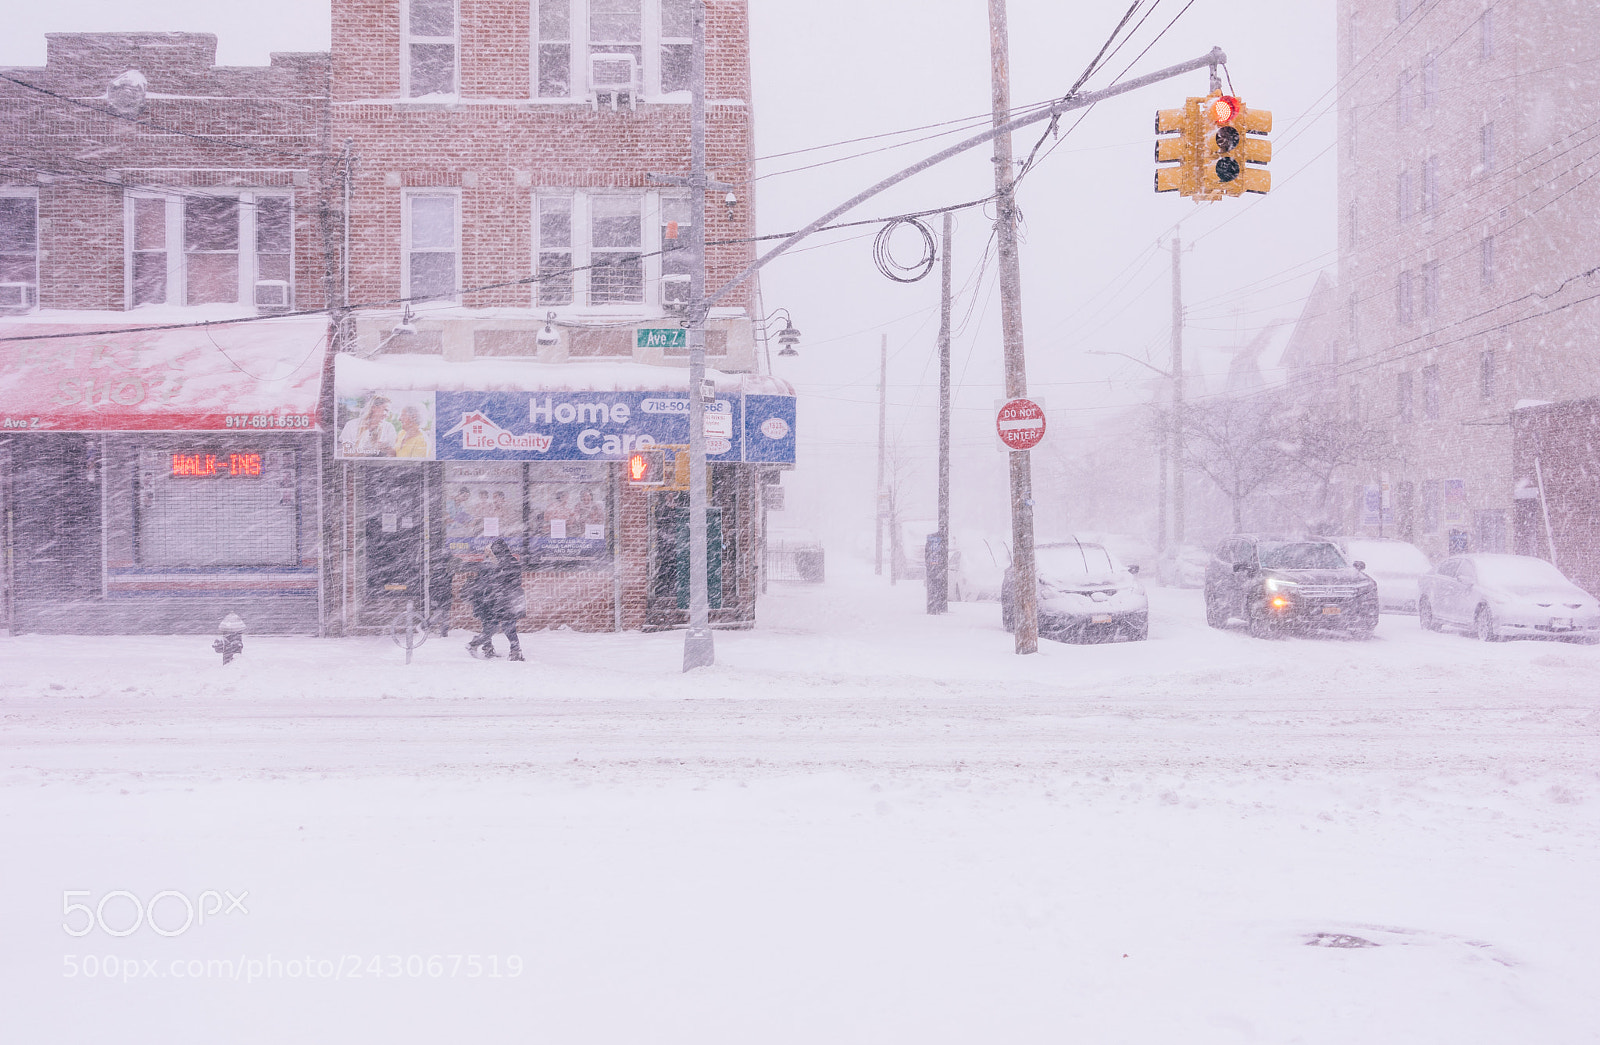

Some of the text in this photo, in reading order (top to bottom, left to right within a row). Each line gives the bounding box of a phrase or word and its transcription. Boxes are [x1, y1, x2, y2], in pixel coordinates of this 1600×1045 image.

[647, 331, 679, 346] Ave Z
[529, 398, 630, 424] Home
[1004, 408, 1036, 418] DO NOT
[3, 417, 41, 428] Ave Z
[225, 415, 309, 428] 917-681-6536
[466, 432, 550, 449] Life Quality
[576, 429, 656, 455] Care
[1008, 431, 1036, 441] ENTER
[173, 454, 261, 475] WALK-INS
